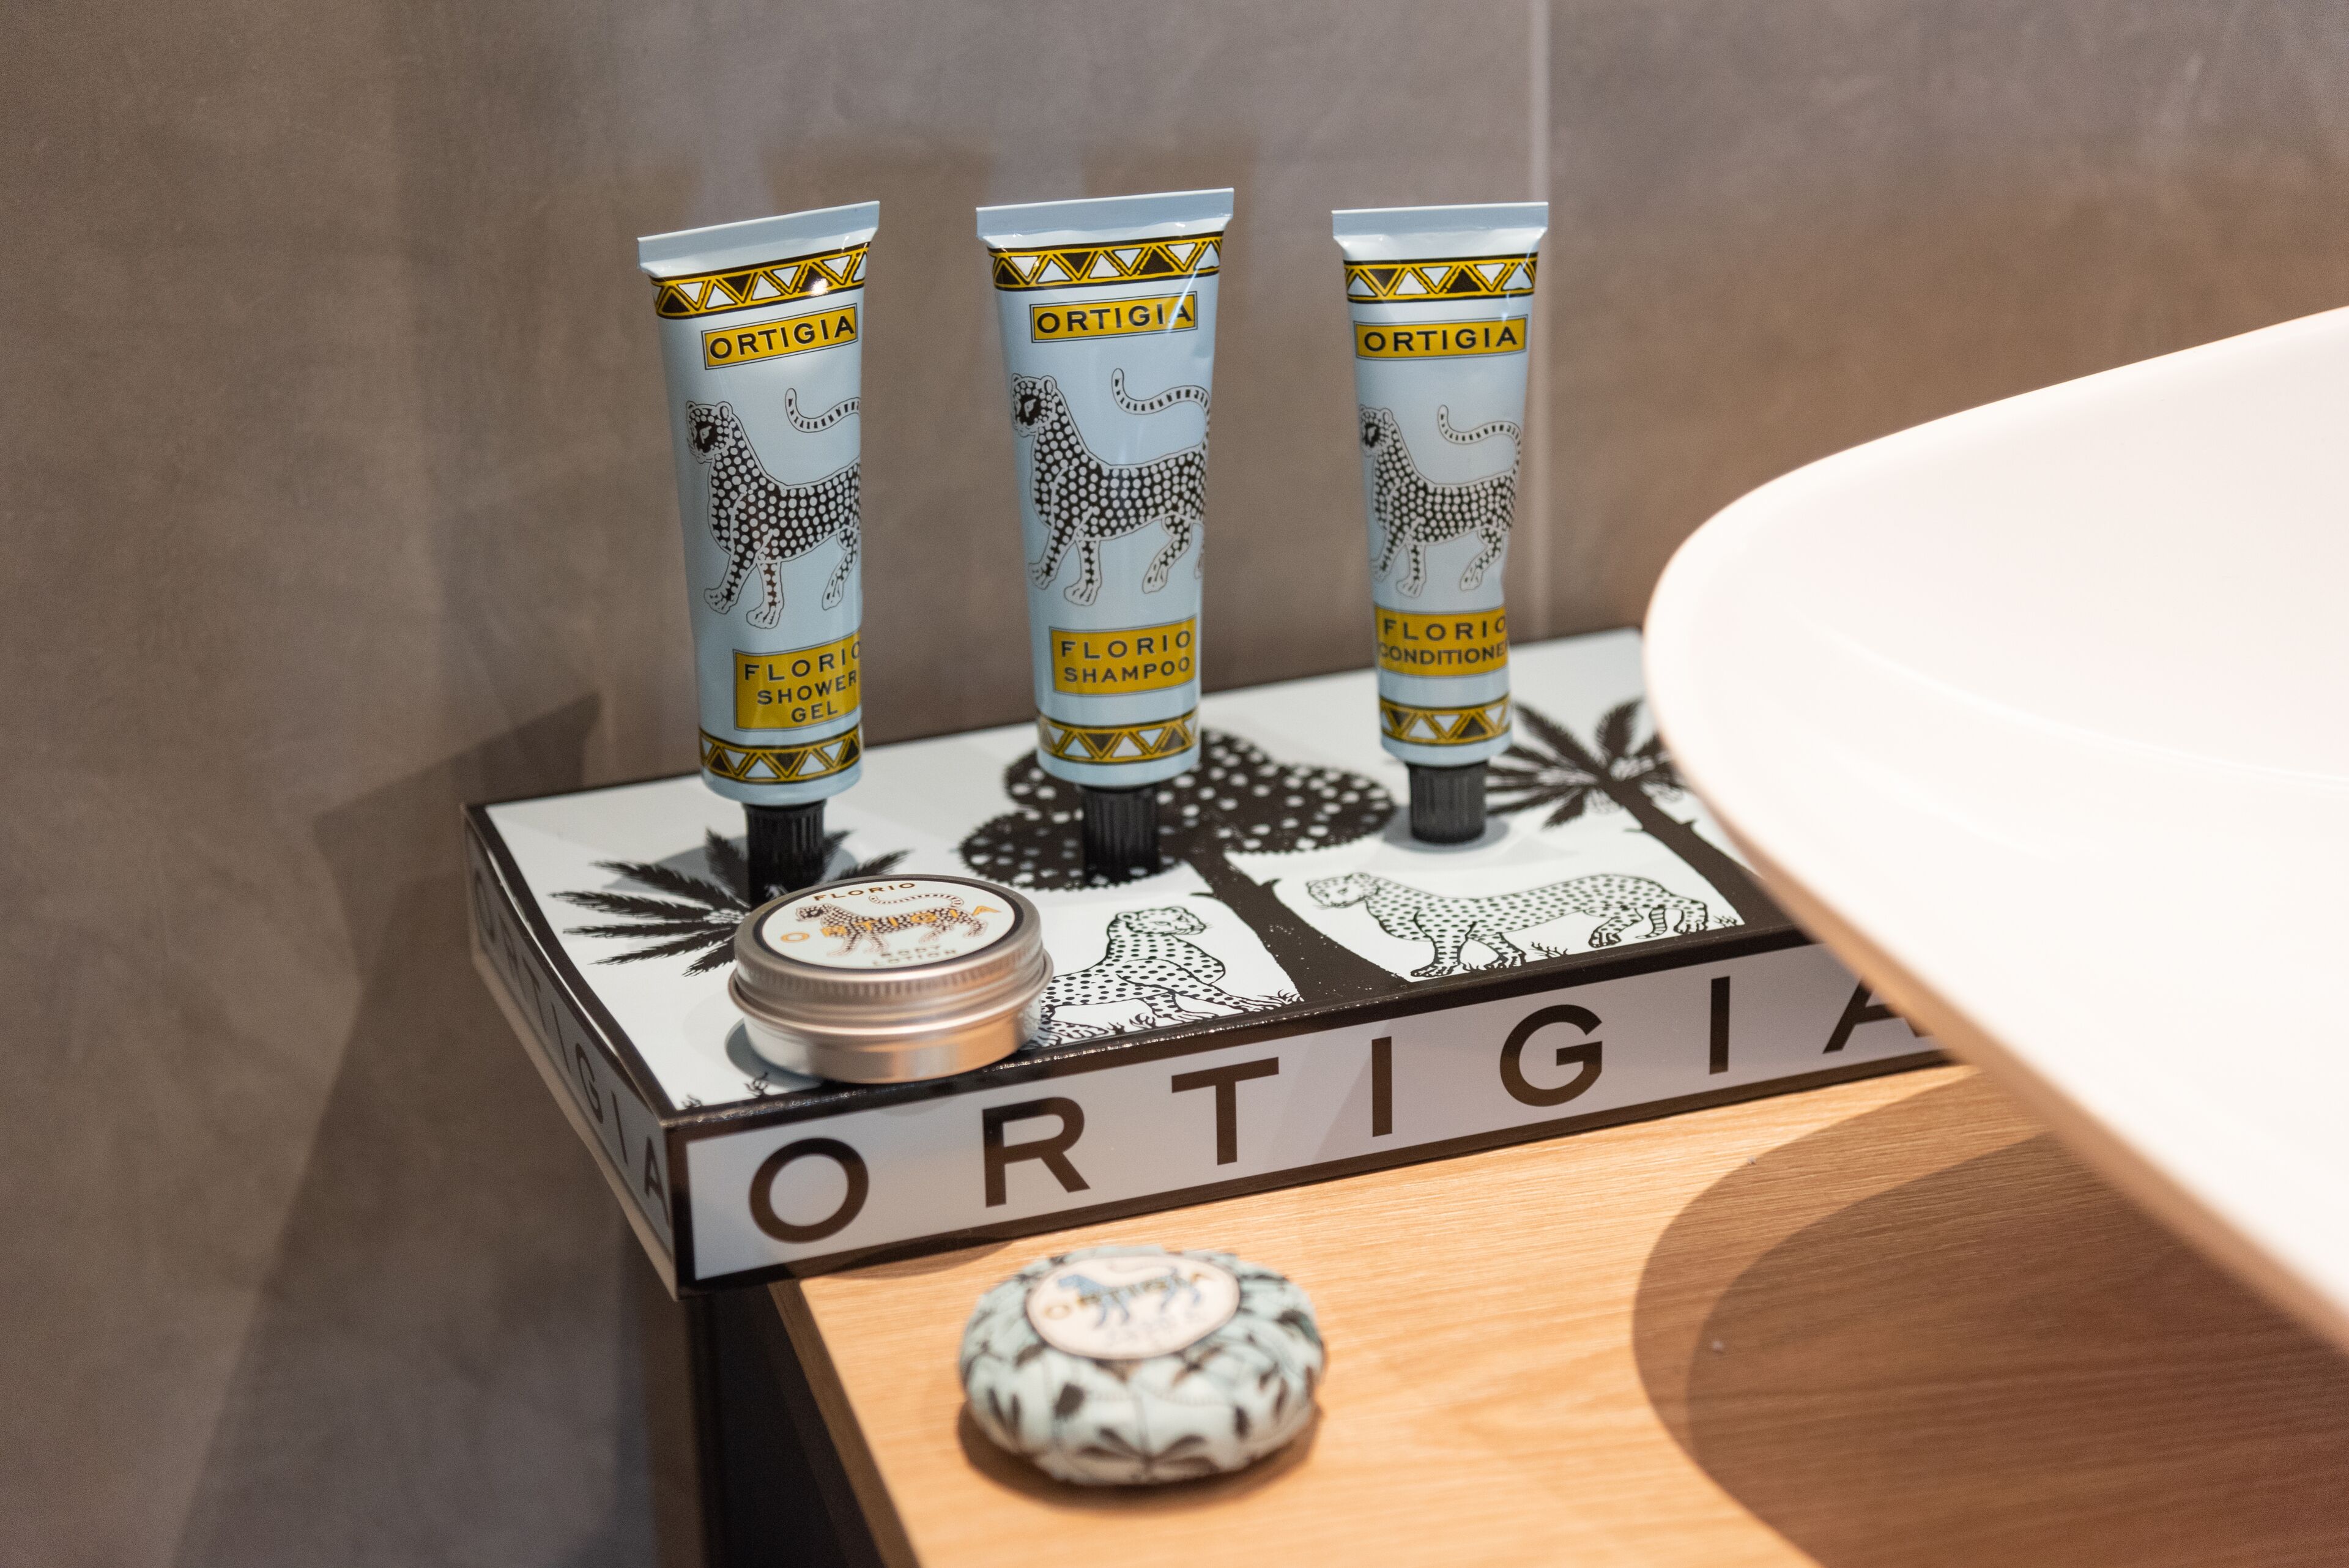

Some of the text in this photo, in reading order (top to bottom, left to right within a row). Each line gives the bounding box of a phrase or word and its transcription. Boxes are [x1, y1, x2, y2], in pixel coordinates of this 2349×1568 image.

[1036, 302, 1192, 334] ORTIGIA
[710, 316, 855, 359] ORTIGIA
[1364, 325, 1518, 352] ORTIGIA
[1384, 615, 1506, 641] FLORIO
[1061, 630, 1190, 660] FLORIO
[1379, 642, 1507, 665] CONDITIONE
[1064, 656, 1190, 683] SHAMPOO
[757, 669, 856, 705] SHOWER
[791, 701, 838, 723] GEL
[813, 883, 915, 901] FLORIO
[780, 905, 1002, 943] ORTIGIA
[871, 949, 957, 967] LOTION
[880, 945, 942, 959] BODY
